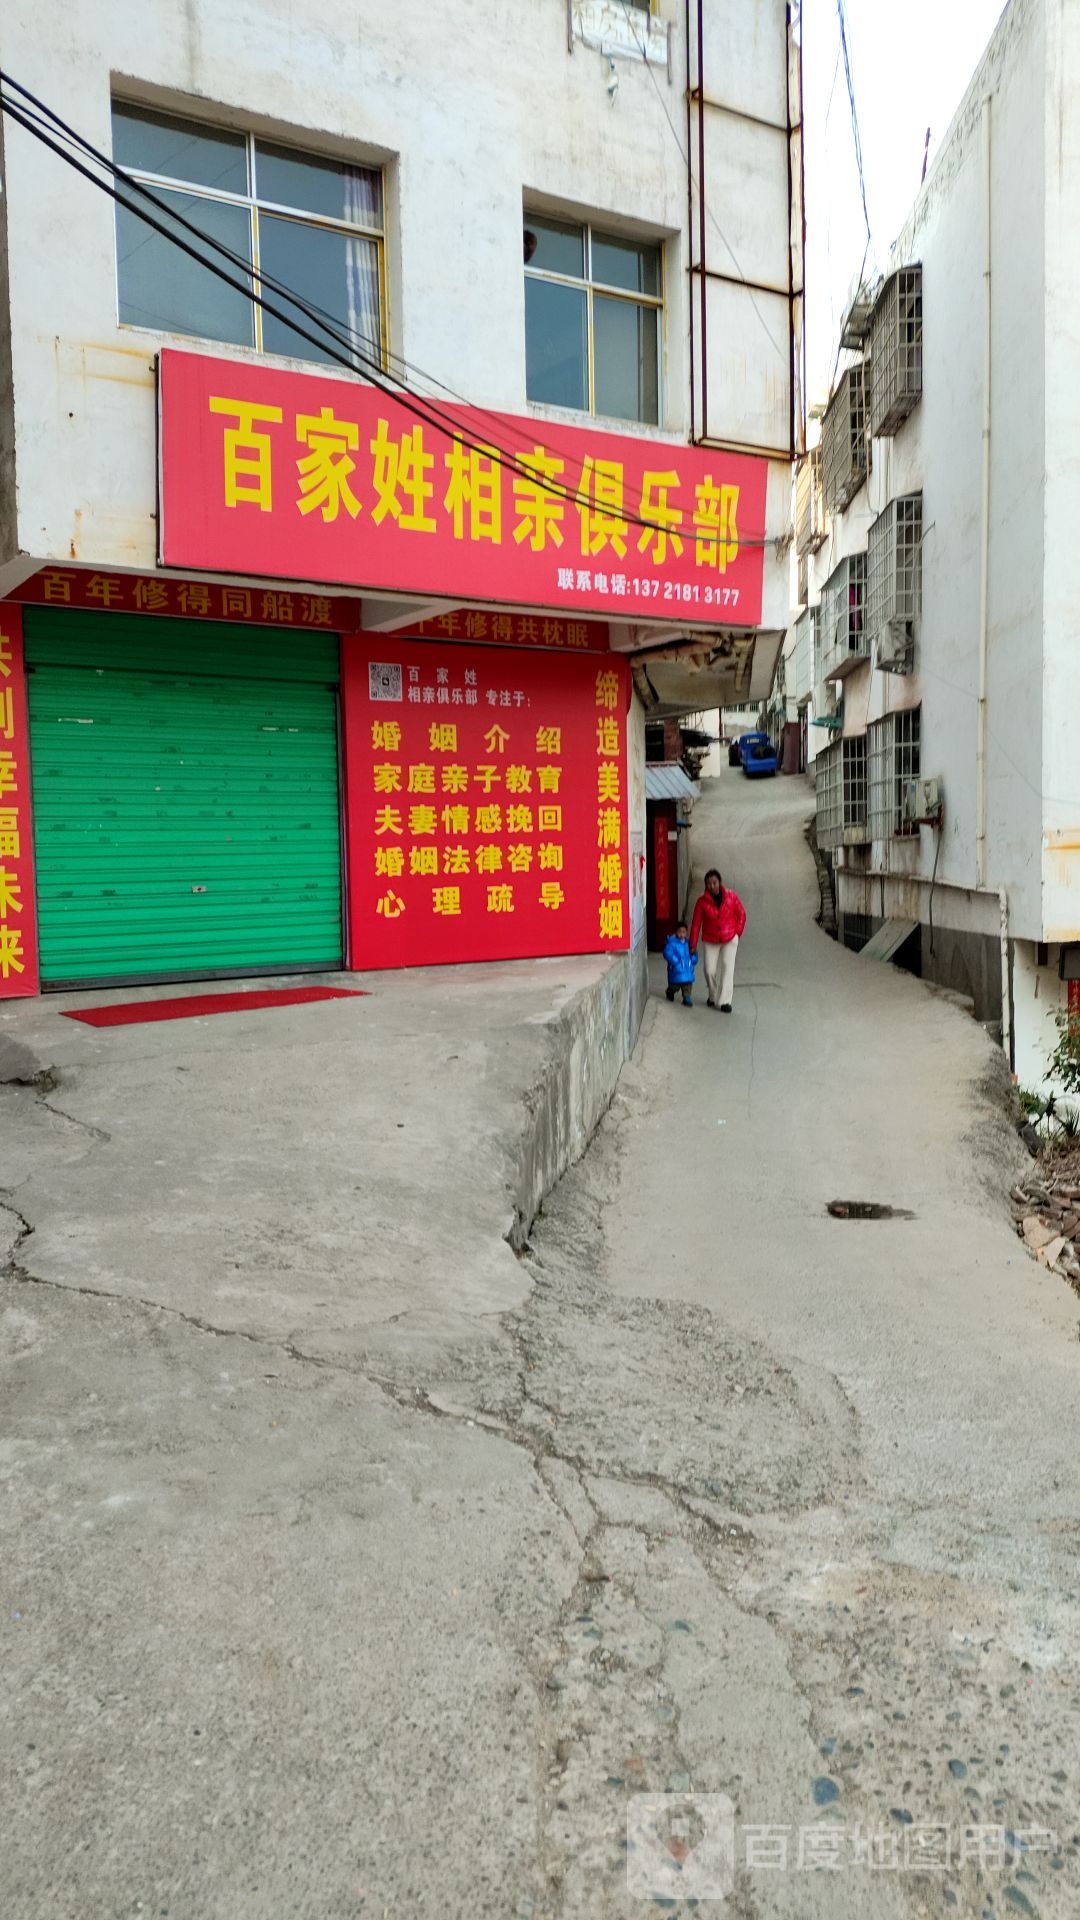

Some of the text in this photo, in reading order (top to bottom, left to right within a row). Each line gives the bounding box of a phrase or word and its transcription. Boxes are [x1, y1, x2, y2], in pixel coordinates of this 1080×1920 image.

[208, 395, 741, 574] 百家姓相亲俱乐部
[39, 571, 333, 624] 百年修得同船渡
[663, 581, 700, 603] 2181
[704, 586, 740, 607] 3177
[407, 685, 478, 706] 相亲俱乐部
[371, 719, 562, 755] 婚姻介绍
[373, 761, 563, 794] 家庭亲子教育
[374, 803, 564, 835] 夫妻情感挽回
[595, 669, 623, 939] 缔造美满婚姻
[374, 841, 564, 877] 婚姻法律咨询
[375, 881, 565, 918] 心理疏导
